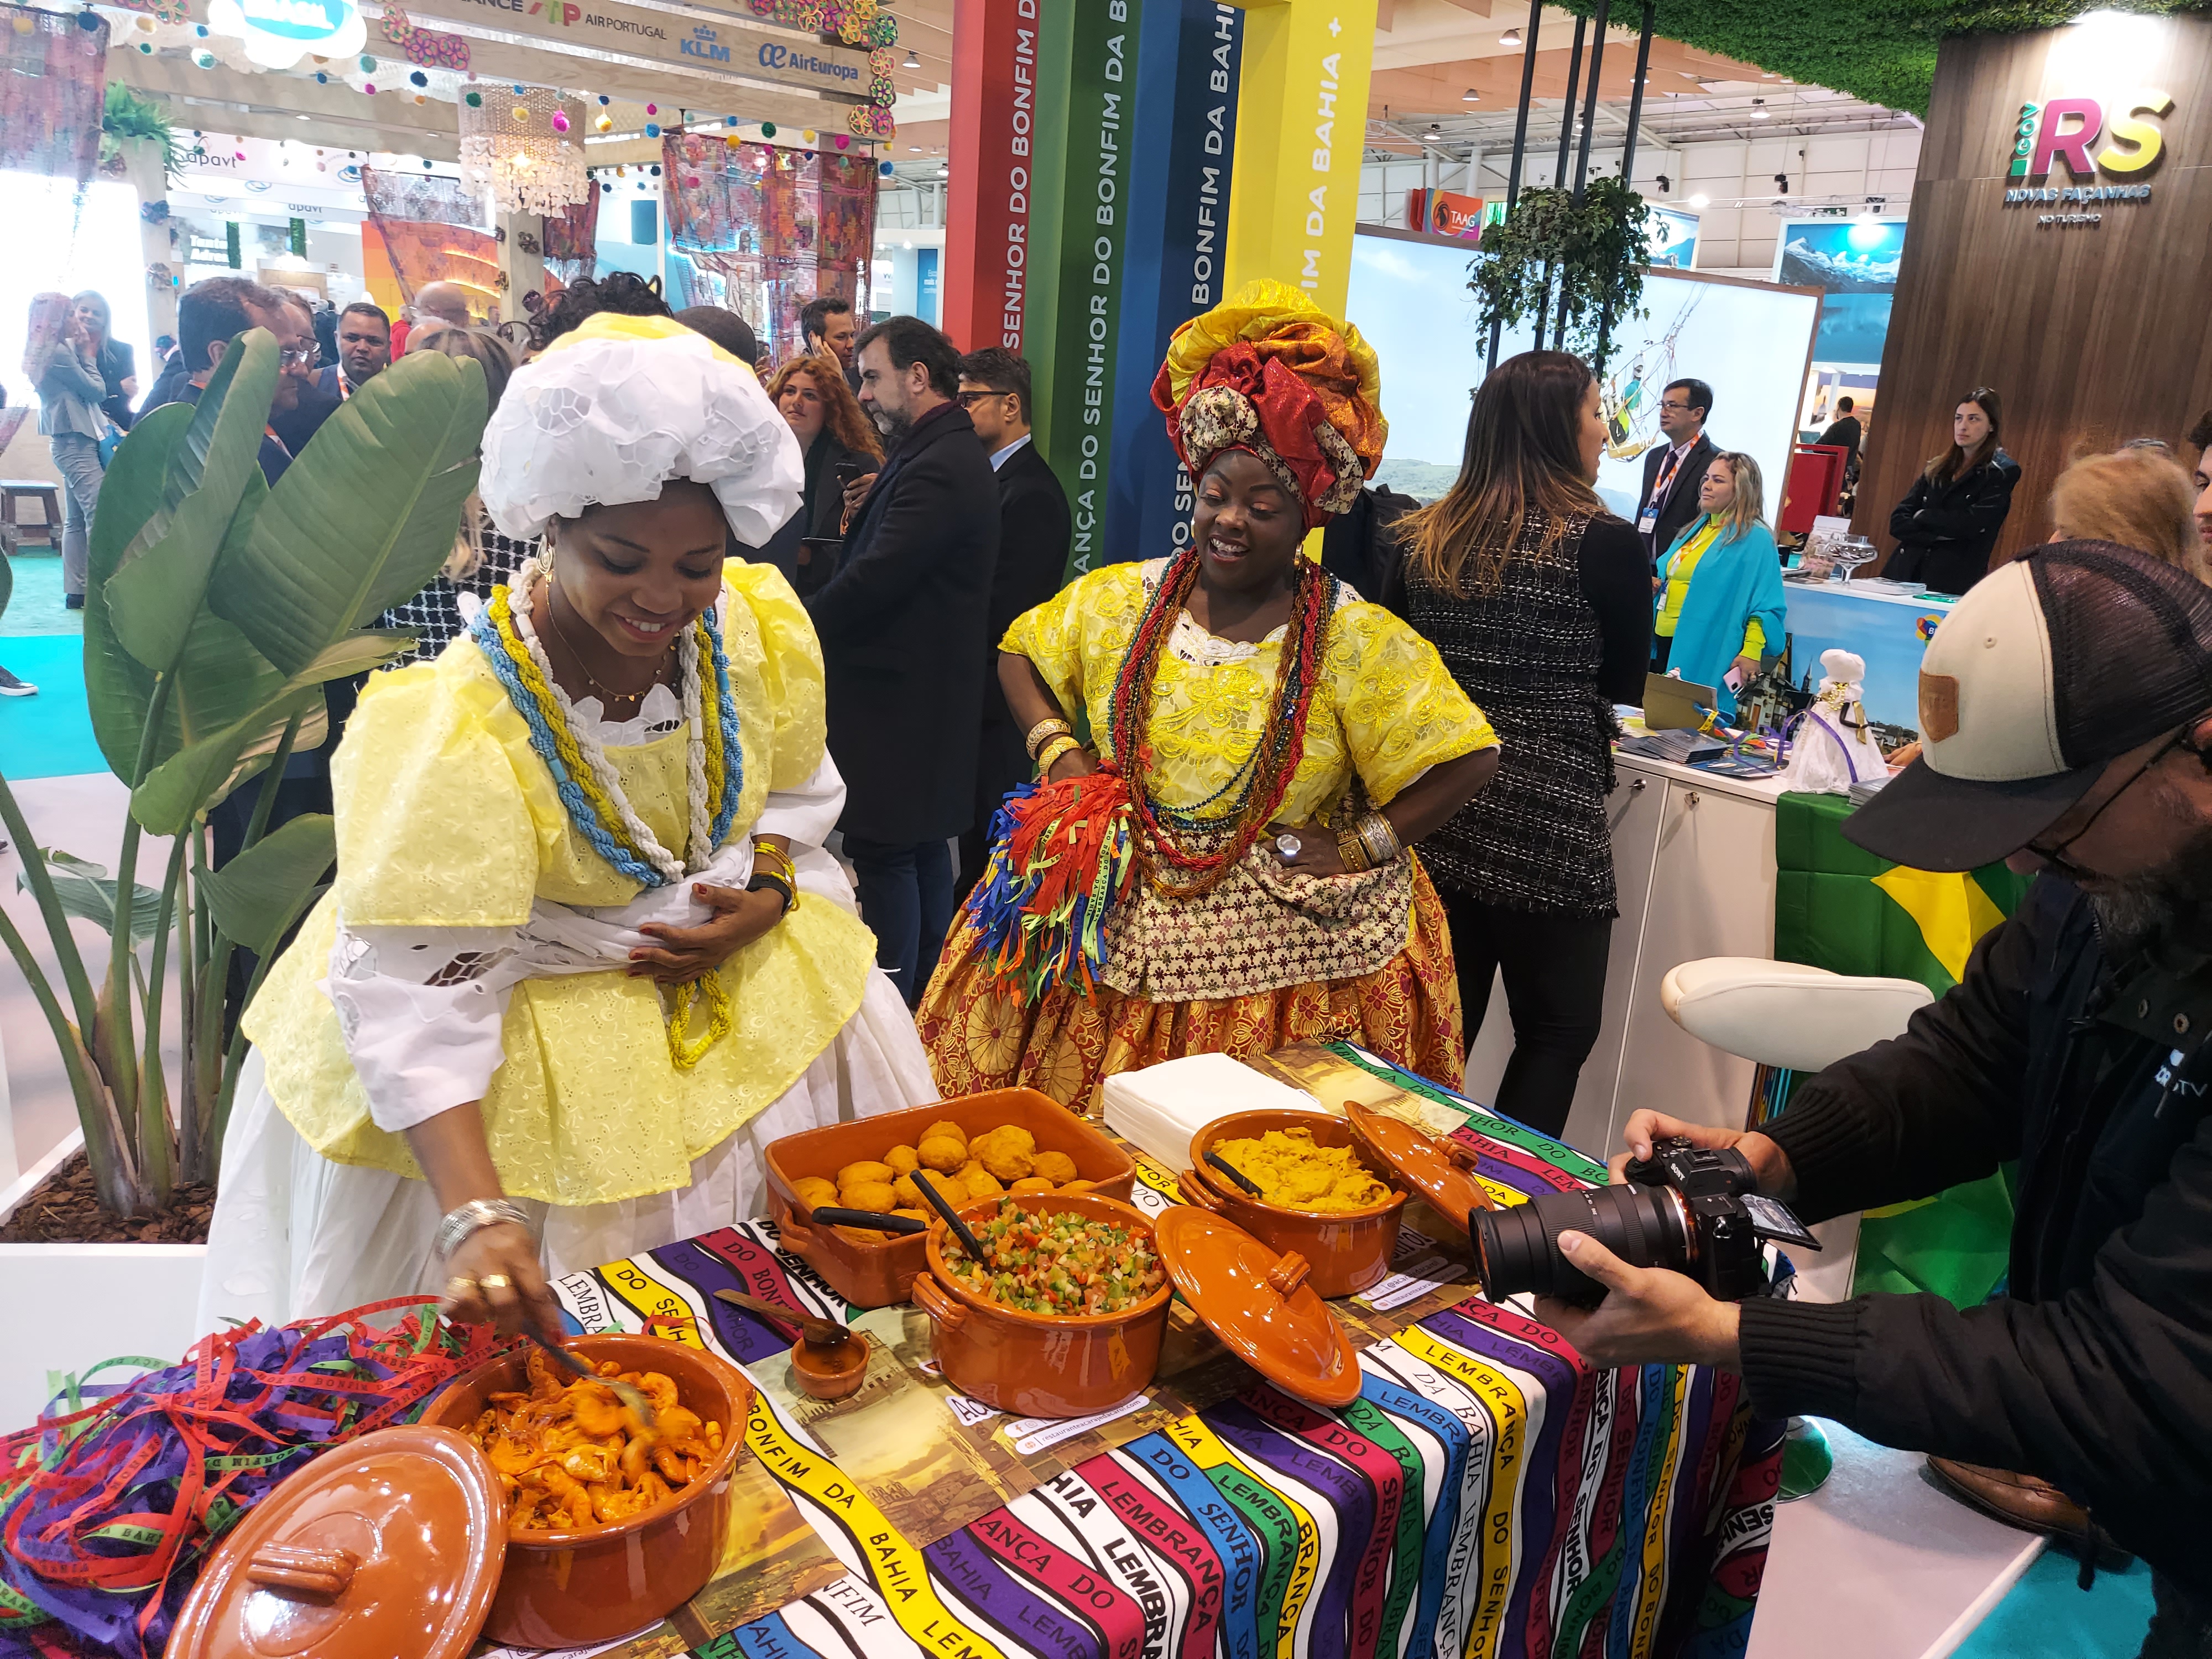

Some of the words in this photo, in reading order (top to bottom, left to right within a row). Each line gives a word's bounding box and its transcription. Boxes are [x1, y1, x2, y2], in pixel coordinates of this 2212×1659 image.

[1109, 2, 1127, 22] B
[680, 38, 730, 62] KLM
[1105, 34, 1125, 82] DA
[1211, 5, 1235, 93] BAHI
[1011, 29, 1034, 156] BONFIM
[1313, 53, 1342, 173] BAHIA
[1204, 106, 1225, 155] DA
[2016, 101, 2039, 156] GOV
[2033, 91, 2172, 175] RS
[1097, 93, 1121, 226] BONFIM
[1009, 166, 1029, 214] DO
[1306, 186, 1327, 237] DA
[2006, 188, 2059, 202] NOVAS
[2063, 184, 2152, 205] FAÇANHAS
[1192, 167, 1220, 305] BONFIM
[1451, 210, 1476, 227] TAAG
[2038, 215, 2053, 223] NO
[2057, 213, 2102, 223] TURISMO
[1003, 222, 1026, 349] SENHOR
[1093, 236, 1112, 285] DO
[1083, 295, 1107, 429] SENHOR
[1081, 435, 1099, 480] DO
[1073, 491, 1095, 581] ANÇA
[1408, 1084, 1435, 1099] DO
[1537, 1142, 1566, 1159] DO
[1580, 1167, 1610, 1182] BO
[1137, 1163, 1171, 1188] HOR
[1483, 1185, 1506, 1200] DA
[1541, 1168, 1582, 1191] LEM
[1670, 1162, 1686, 1182] SONY
[1132, 1188, 1160, 1207] DO
[723, 1241, 757, 1261] DO
[756, 1220, 781, 1241] DO
[557, 1274, 608, 1335] LEMBRA
[615, 1269, 647, 1290] DO
[674, 1253, 700, 1271] DO
[721, 1301, 754, 1353] ENHOR
[1428, 1316, 1465, 1339] HIA
[1519, 1322, 1559, 1344] DO
[348, 1422, 366, 1437] DO
[432, 1369, 448, 1384] DO
[1412, 1371, 1447, 1395] DA
[1425, 1344, 1519, 1471] LEMBRANÇA
[1595, 1368, 1612, 1435] ANÇA
[1619, 1383, 1632, 1416] DO
[1649, 1368, 1662, 1404] DO
[1720, 1372, 1732, 1402] DO
[1175, 1418, 1203, 1449] HIA
[1243, 1390, 1306, 1431] ANÇA
[1350, 1407, 1384, 1431] DA
[1324, 1429, 1368, 1457] DO
[1380, 1391, 1467, 1513] LEMBRANÇA
[1453, 1405, 1488, 1492] BAHIA
[1585, 1439, 1604, 1481] DO
[1387, 1444, 1418, 1537] BAHIA
[1601, 1428, 1631, 1536] SENHOR
[1647, 1447, 1676, 1548] SENHOR
[747, 1404, 811, 1479] BONFIM
[822, 1482, 855, 1509] DA
[869, 1532, 918, 1603] BAHIA
[922, 1620, 984, 1659] LEM
[1149, 1448, 1191, 1480] DO
[1197, 1503, 1254, 1614] SENHOR
[1218, 1474, 1294, 1618] LEMBRANÇA
[1359, 1477, 1399, 1598] SENHOR
[1493, 1511, 1509, 1544] DO
[978, 1519, 1052, 1573] ANÇA
[1068, 1573, 1115, 1609] DO
[1044, 1474, 1098, 1519] HIA
[1102, 1537, 1168, 1659] LEMBRA
[1100, 1480, 1221, 1634] LEMBRANÇA
[1277, 1520, 1314, 1643] BRANÇA
[1438, 1499, 1478, 1658] LEMBRANÇA
[1606, 1546, 1625, 1575] DO
[1648, 1562, 1660, 1594] DO
[822, 1579, 886, 1627] NFIM
[1357, 1605, 1375, 1647] DO
[1376, 1545, 1416, 1659] LEMBRA
[1471, 1564, 1509, 1659] SENHO
[1017, 1605, 1088, 1659] LEMB
